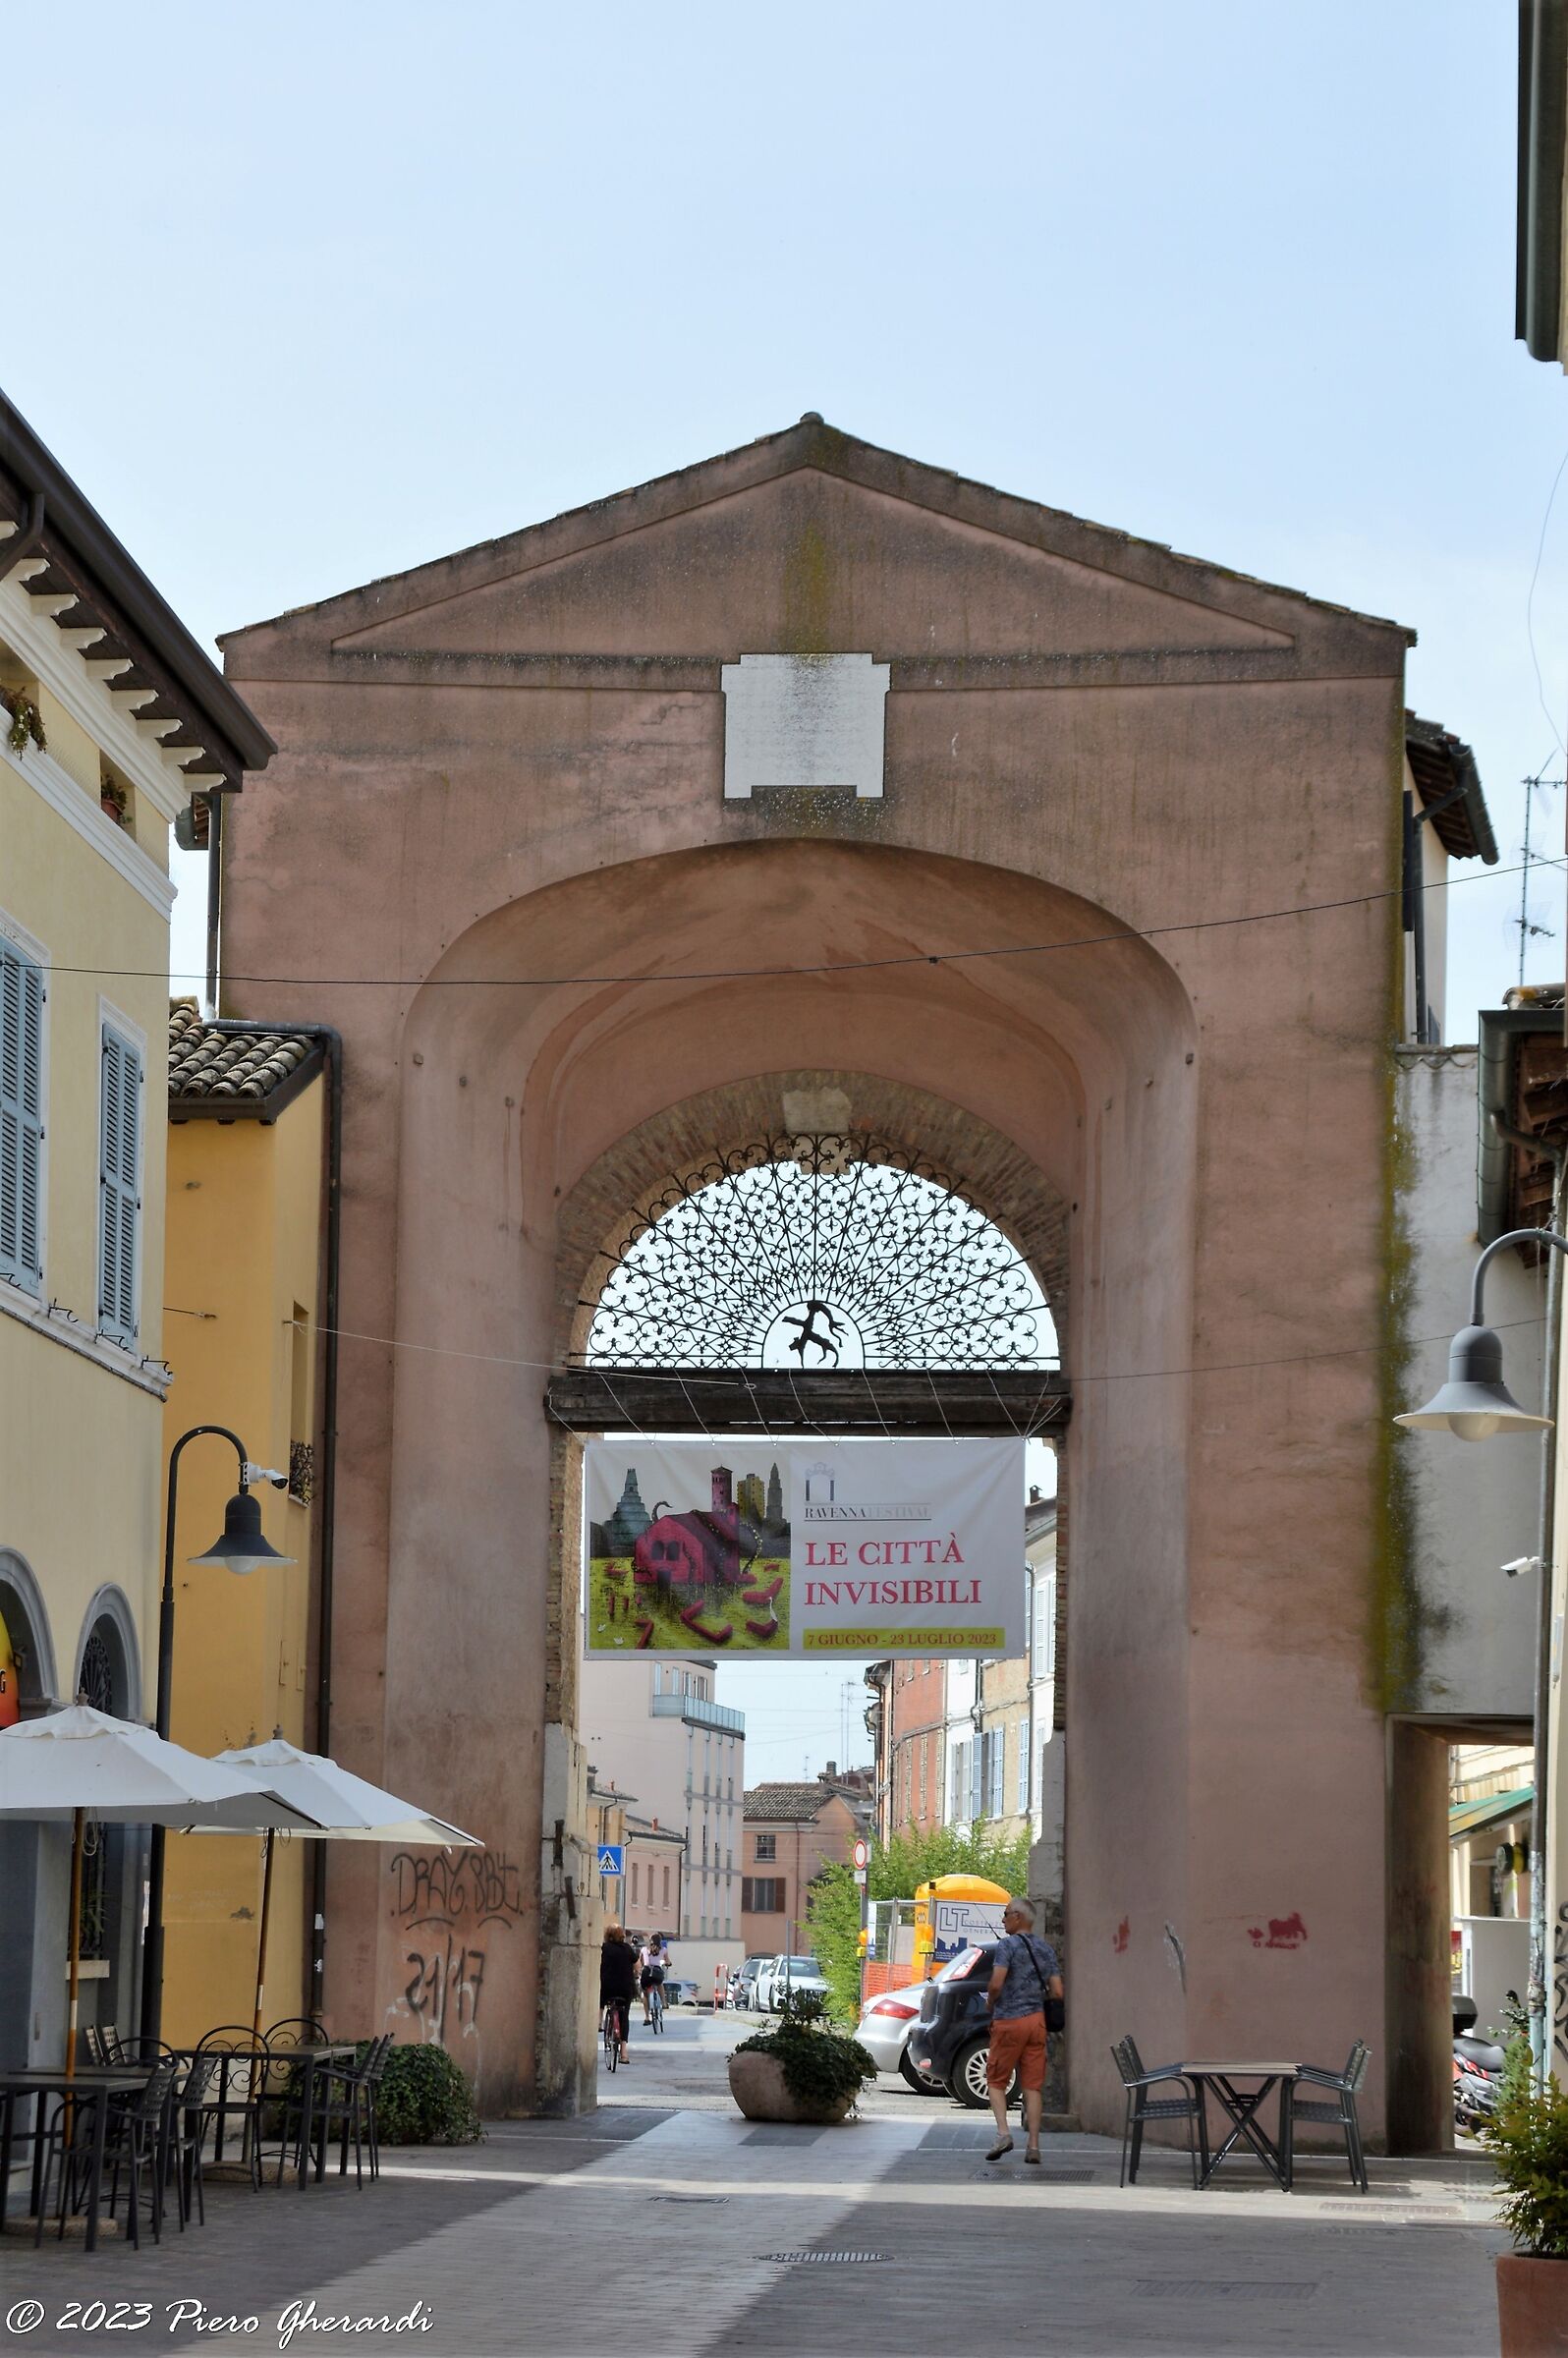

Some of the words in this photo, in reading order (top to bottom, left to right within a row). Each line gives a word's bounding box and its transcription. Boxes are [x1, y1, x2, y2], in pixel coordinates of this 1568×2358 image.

[805, 1542, 848, 1566] LE
[858, 1532, 965, 1565] CITTÀ
[804, 1580, 982, 1605] INVISIBILI
[808, 1634, 815, 1646] 7
[817, 1634, 878, 1646] GIUGNO
[890, 1633, 905, 1645] 23
[908, 1633, 965, 1646] LUGLIO
[968, 1633, 996, 1645] 2023
